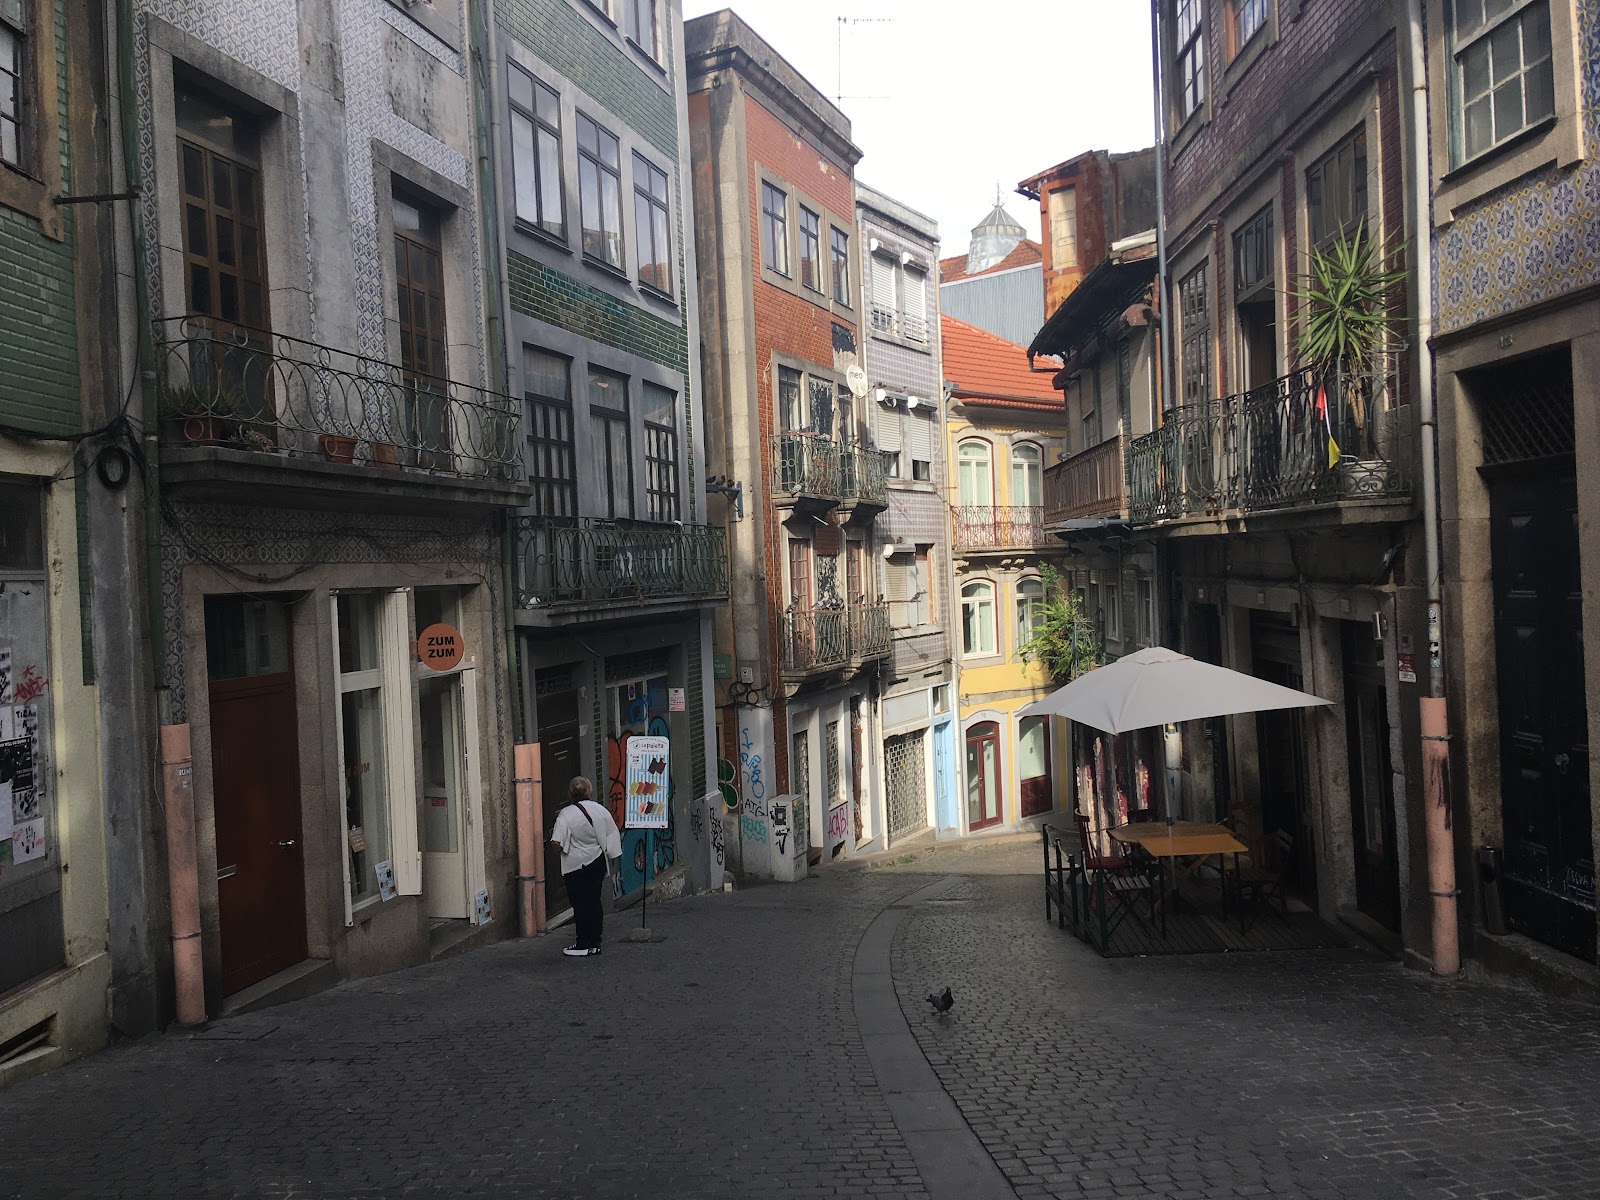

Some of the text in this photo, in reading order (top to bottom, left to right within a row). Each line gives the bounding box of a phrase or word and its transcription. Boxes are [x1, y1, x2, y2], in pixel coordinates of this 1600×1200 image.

[849, 371, 863, 379] meo
[427, 636, 455, 646] ZUM
[428, 648, 455, 658] ZUM
[828, 804, 849, 840] ACAB!
